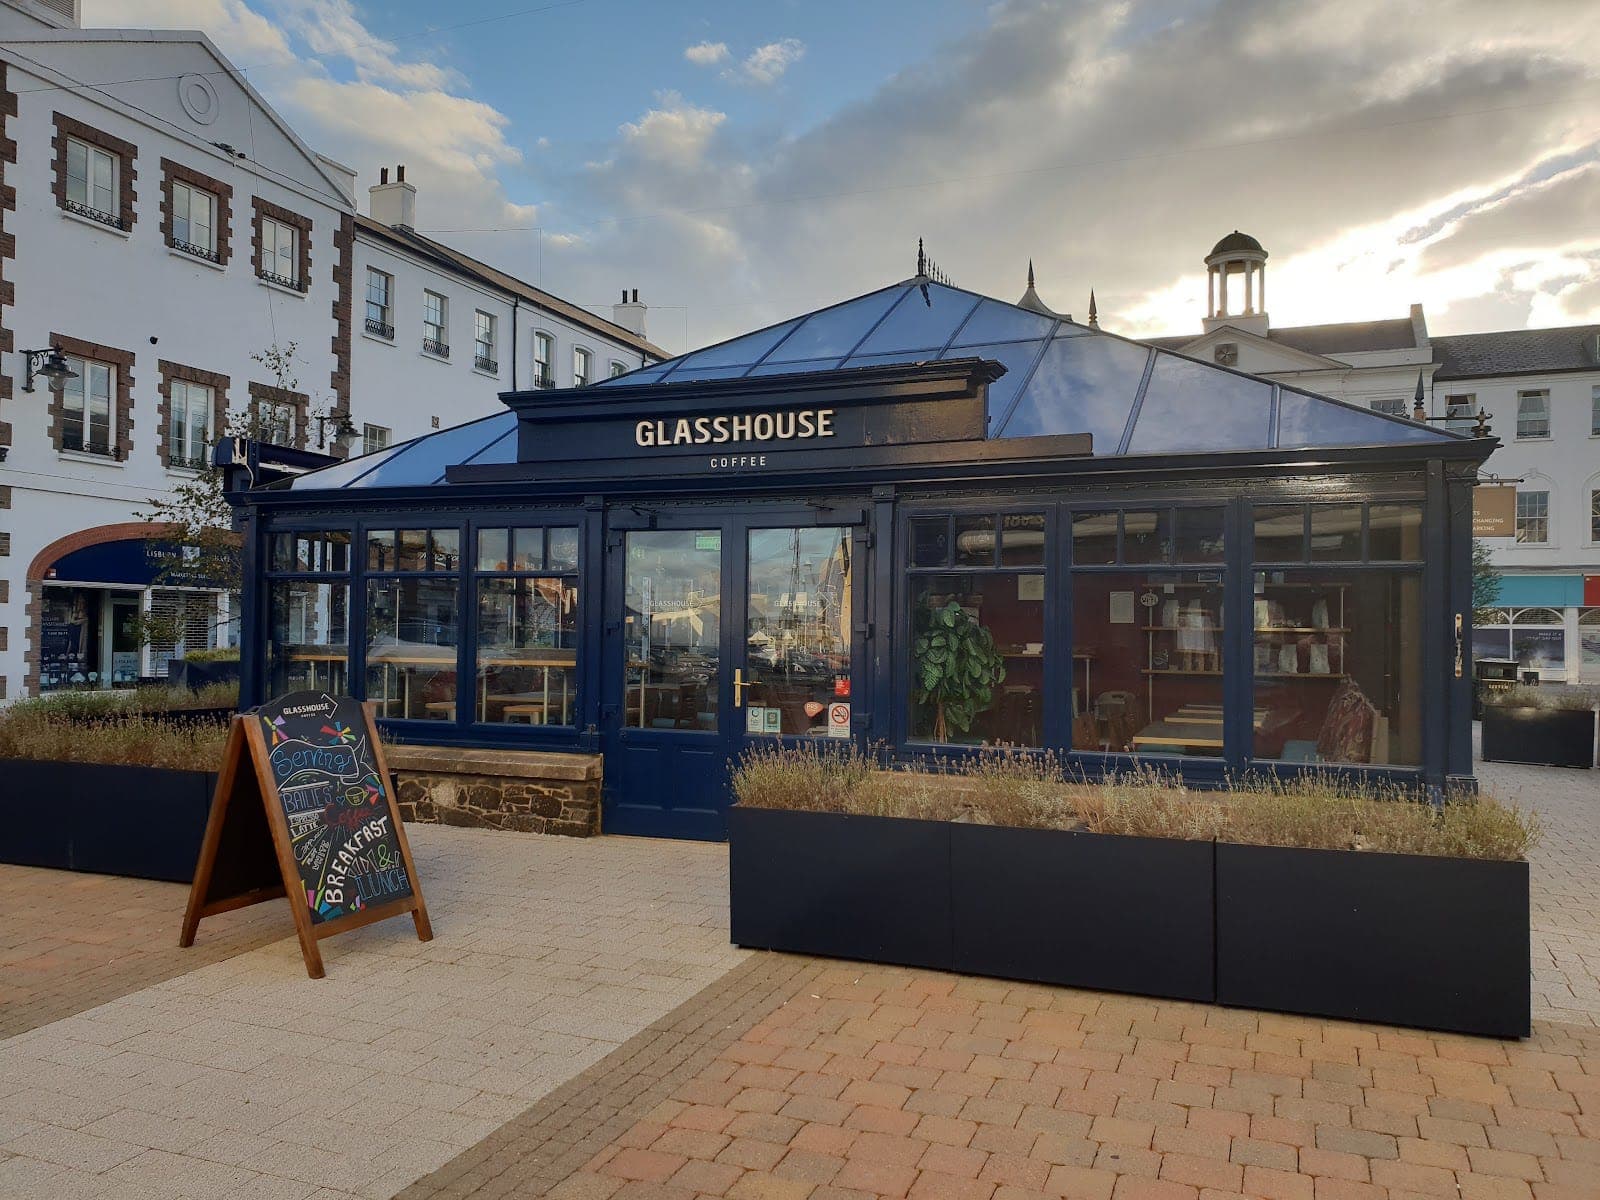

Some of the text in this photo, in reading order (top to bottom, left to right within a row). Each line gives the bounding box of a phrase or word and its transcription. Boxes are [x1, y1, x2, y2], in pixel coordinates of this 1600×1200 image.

[635, 409, 835, 447] GLASSHOUSE
[710, 456, 767, 468] COFFEE
[283, 702, 330, 715] GLASSHOUSE
[272, 748, 352, 777] Serving
[290, 821, 320, 838] LATTE
[325, 815, 388, 903] BREAKFAST
[377, 844, 394, 868] &
[355, 867, 410, 901] LUNCH
